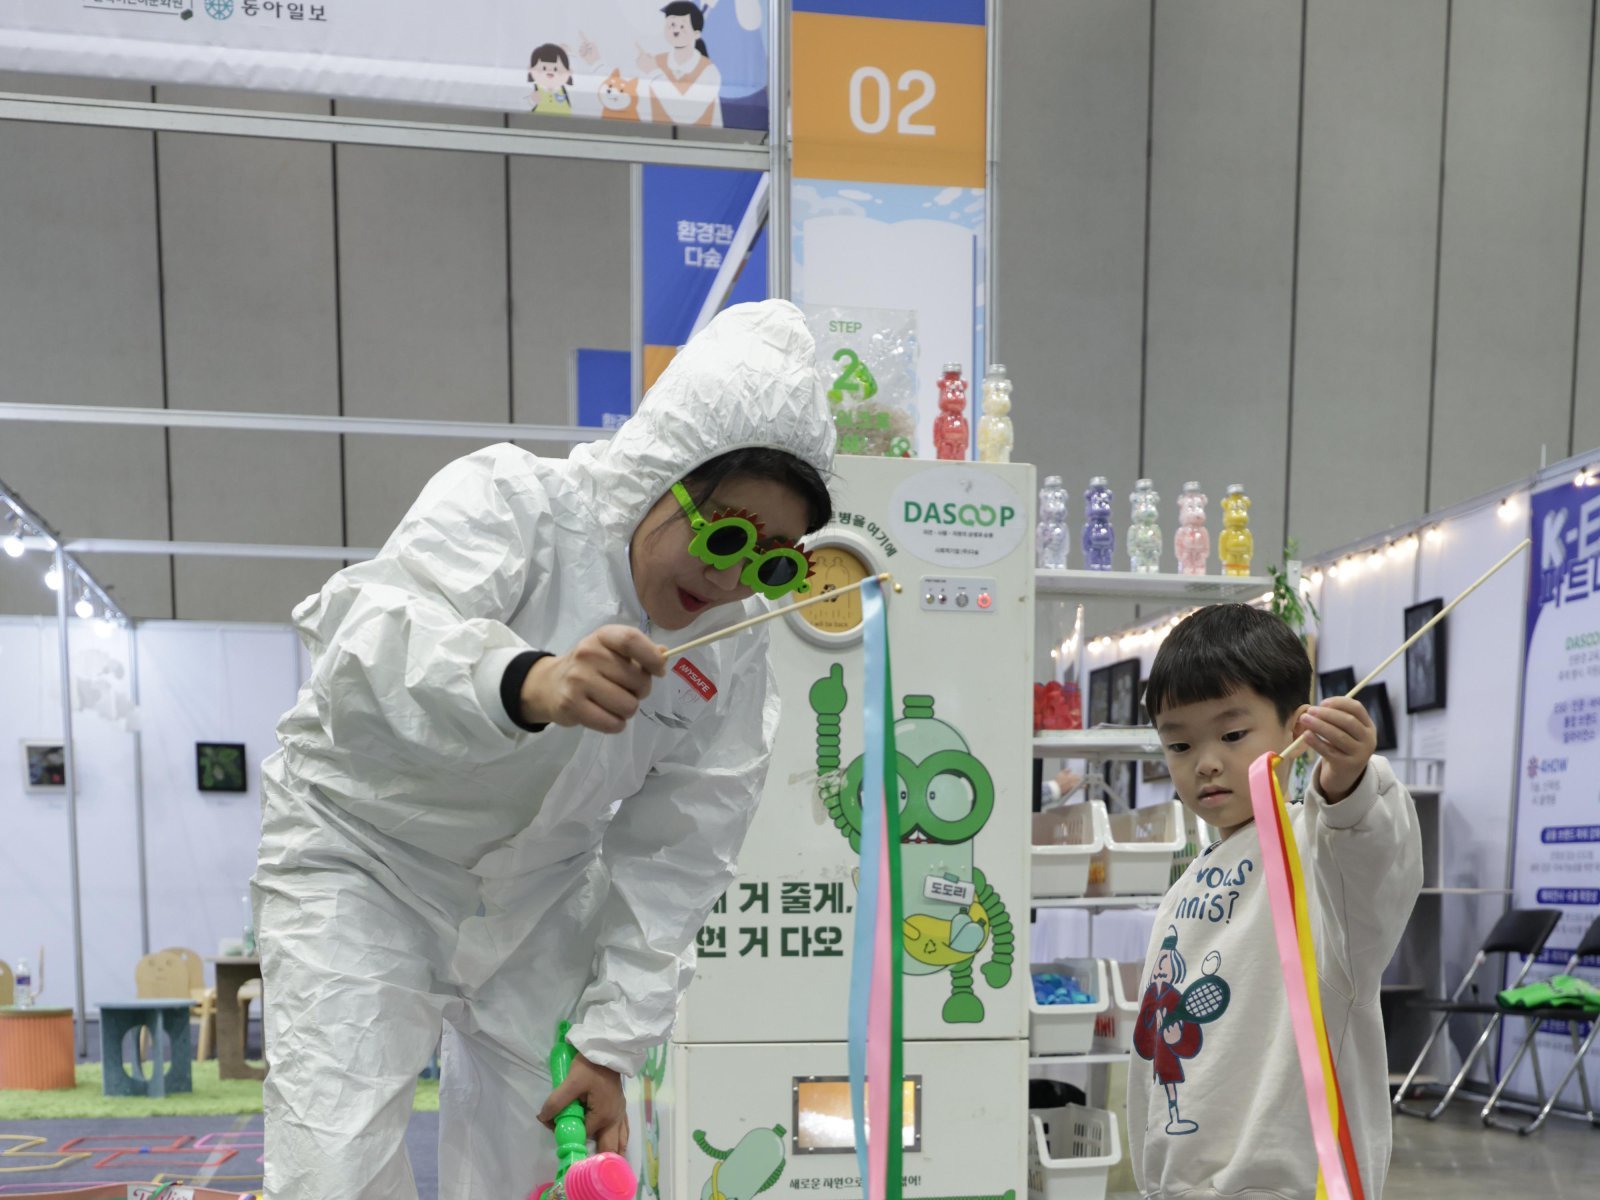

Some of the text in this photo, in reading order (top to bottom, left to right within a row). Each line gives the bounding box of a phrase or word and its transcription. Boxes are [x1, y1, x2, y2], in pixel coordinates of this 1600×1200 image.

[241, 0, 327, 22] 동아일보
[849, 66, 936, 134] 02
[677, 219, 734, 244] 환경관
[829, 320, 862, 334] STEP
[832, 348, 860, 391] 2
[739, 882, 768, 913] 거
[781, 882, 853, 914] 줄게,
[739, 926, 768, 958] 거
[781, 926, 843, 957] 다오
